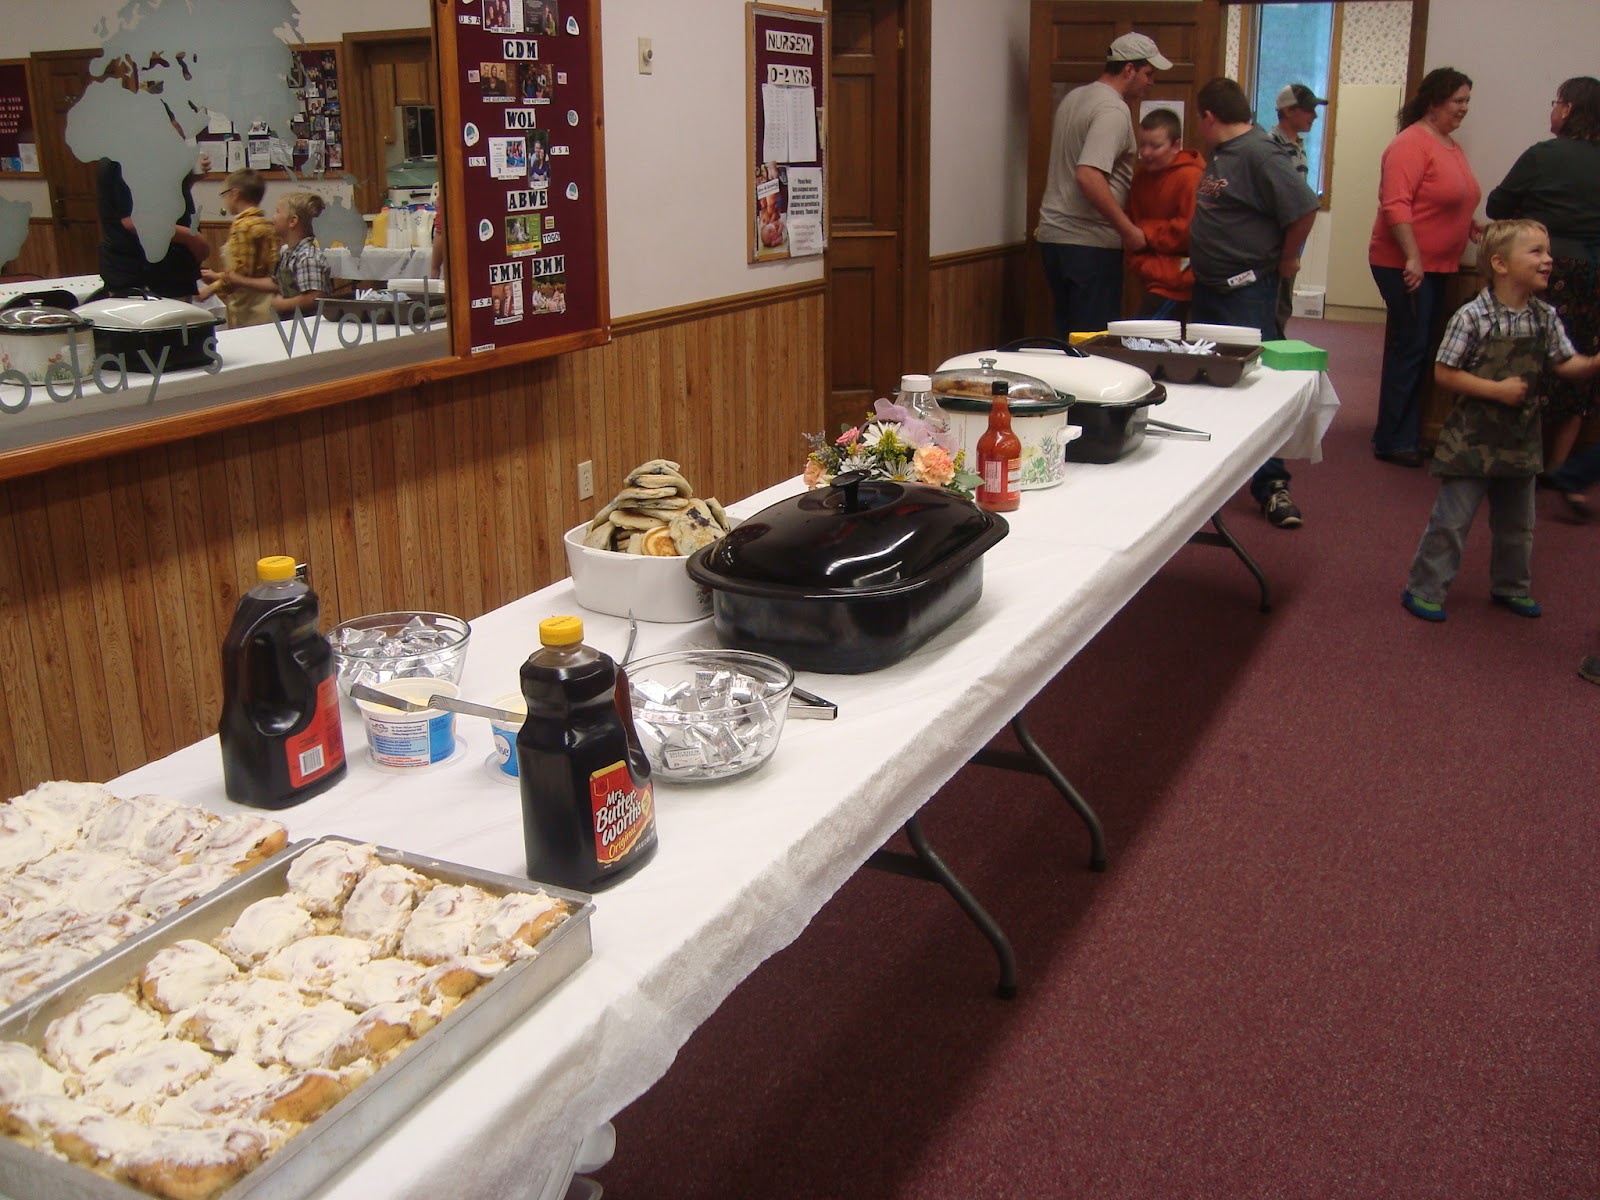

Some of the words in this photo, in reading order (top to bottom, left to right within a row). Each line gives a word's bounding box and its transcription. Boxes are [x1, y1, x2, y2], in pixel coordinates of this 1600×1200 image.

[504, 41, 537, 59] CDM
[767, 33, 812, 52] NURSERY
[792, 69, 810, 85] YRS
[506, 111, 535, 128] WOL
[551, 146, 569, 154] USA
[470, 157, 486, 166] USA
[508, 190, 547, 210] ABWE
[543, 232, 560, 242] TOGO
[490, 263, 522, 283] FMM
[533, 256, 564, 276] BMM
[269, 275, 431, 360] World
[609, 825, 637, 858] Original
